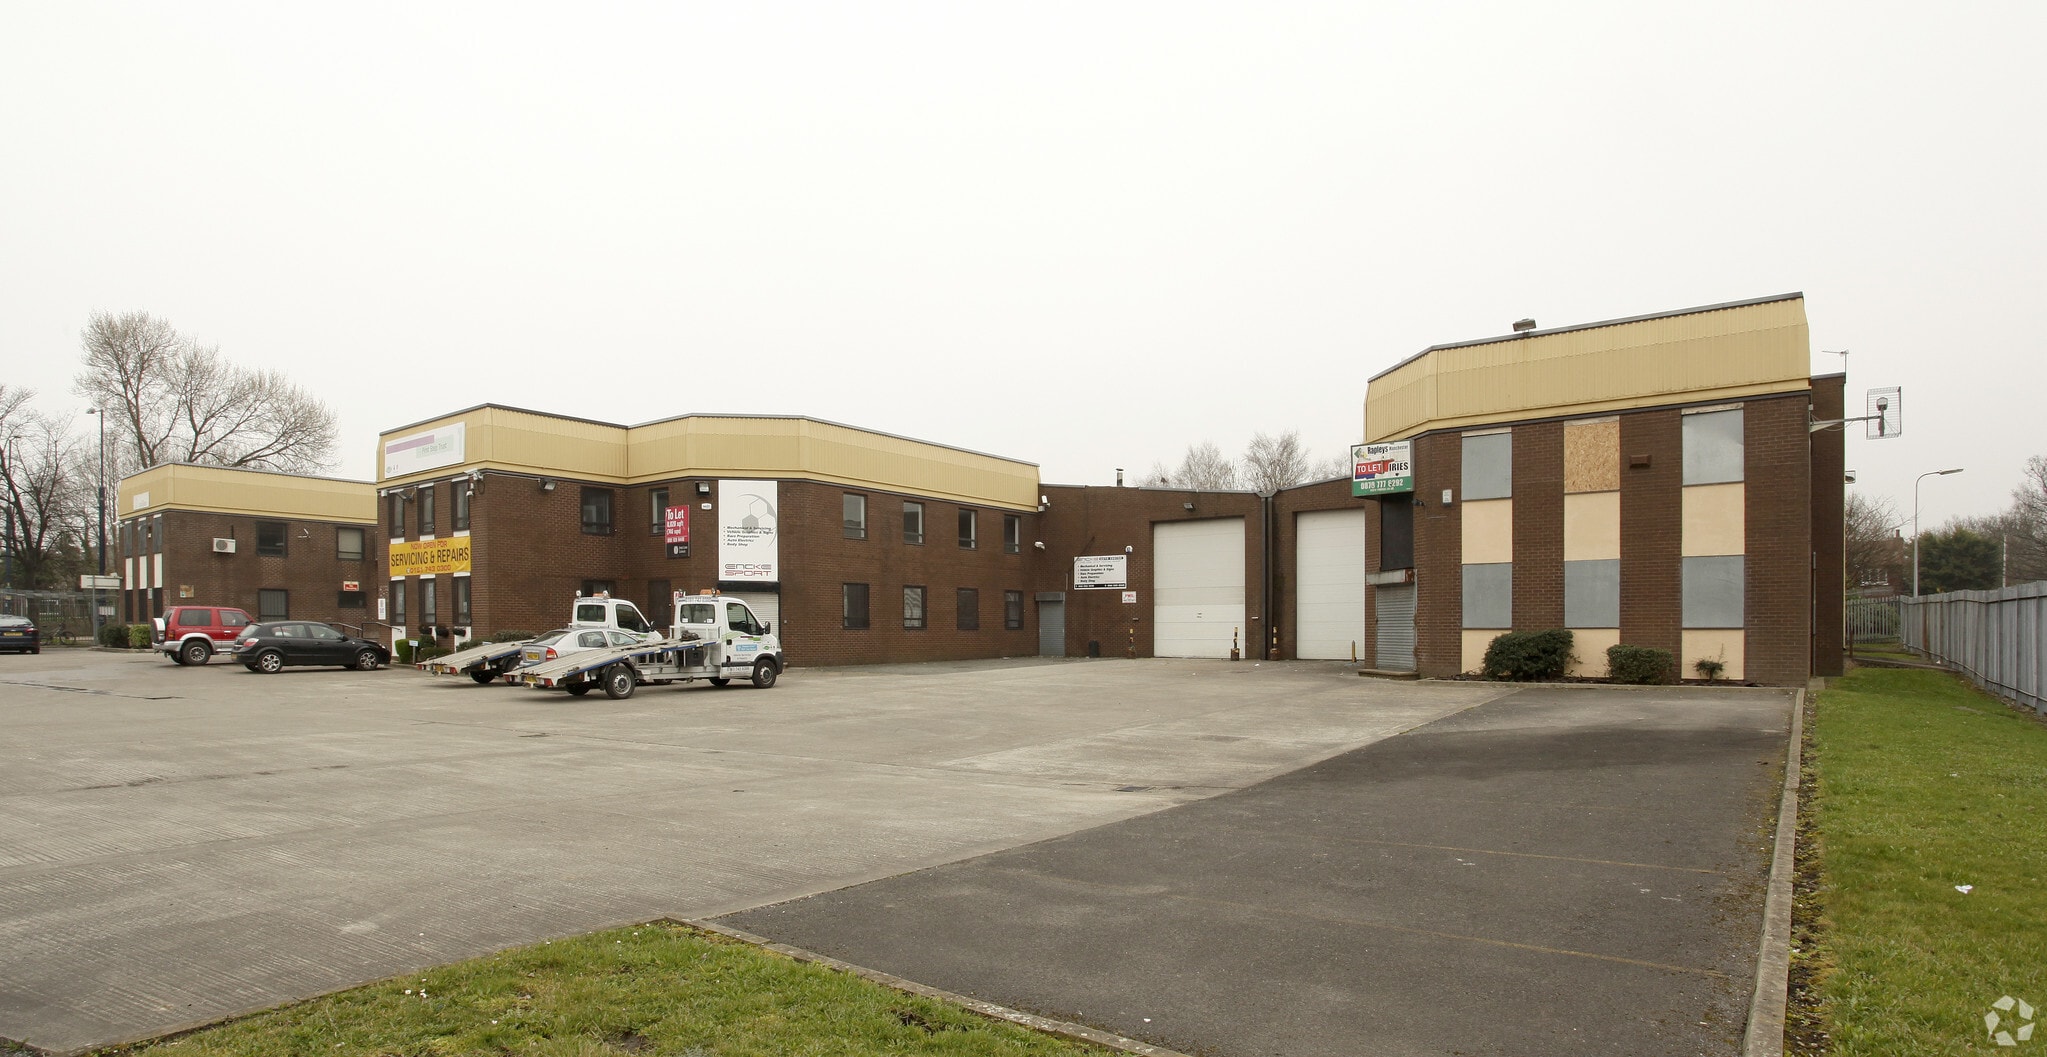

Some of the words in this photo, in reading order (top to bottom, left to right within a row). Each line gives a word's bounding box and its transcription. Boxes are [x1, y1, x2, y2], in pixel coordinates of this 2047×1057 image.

[1368, 446, 1388, 454] Rapleys
[1390, 462, 1408, 471] IRIES
[667, 509, 673, 520] To
[675, 508, 684, 519] Let
[391, 551, 428, 566] SERVICING
[430, 551, 435, 563] &
[437, 547, 469, 562] REPAIRS
